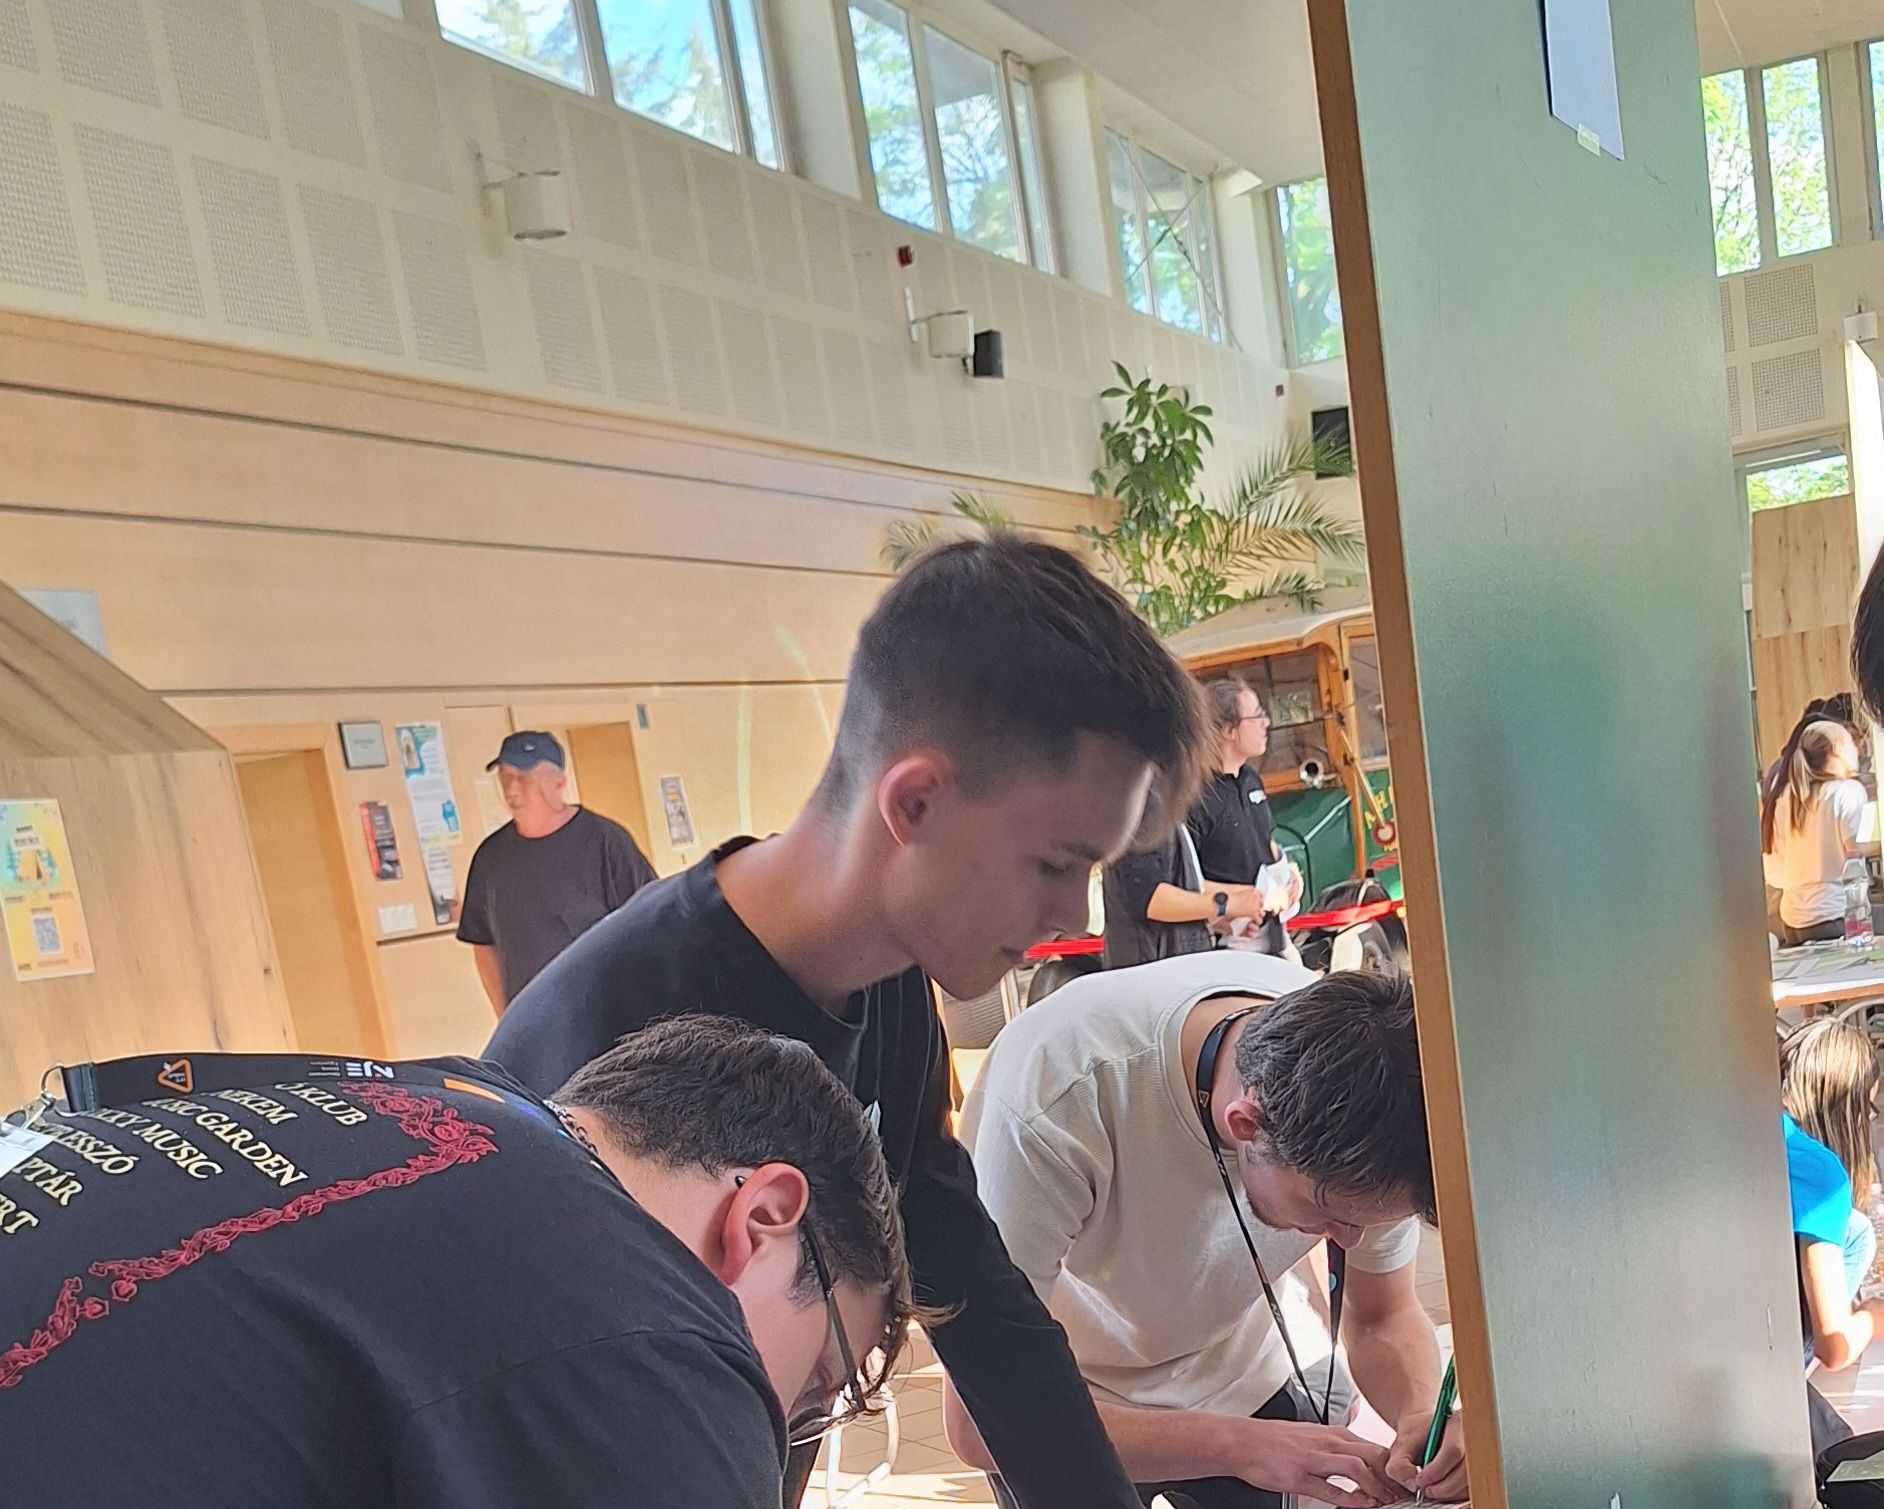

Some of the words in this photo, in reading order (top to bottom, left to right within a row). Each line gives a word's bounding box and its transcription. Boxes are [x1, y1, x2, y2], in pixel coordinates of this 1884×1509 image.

[289, 1087, 368, 1126] KLUB
[132, 1123, 224, 1179] MUSIC
[195, 1112, 309, 1187] GARDEN
[12, 1157, 83, 1206] PTÁR
[0, 1193, 39, 1234] RT
